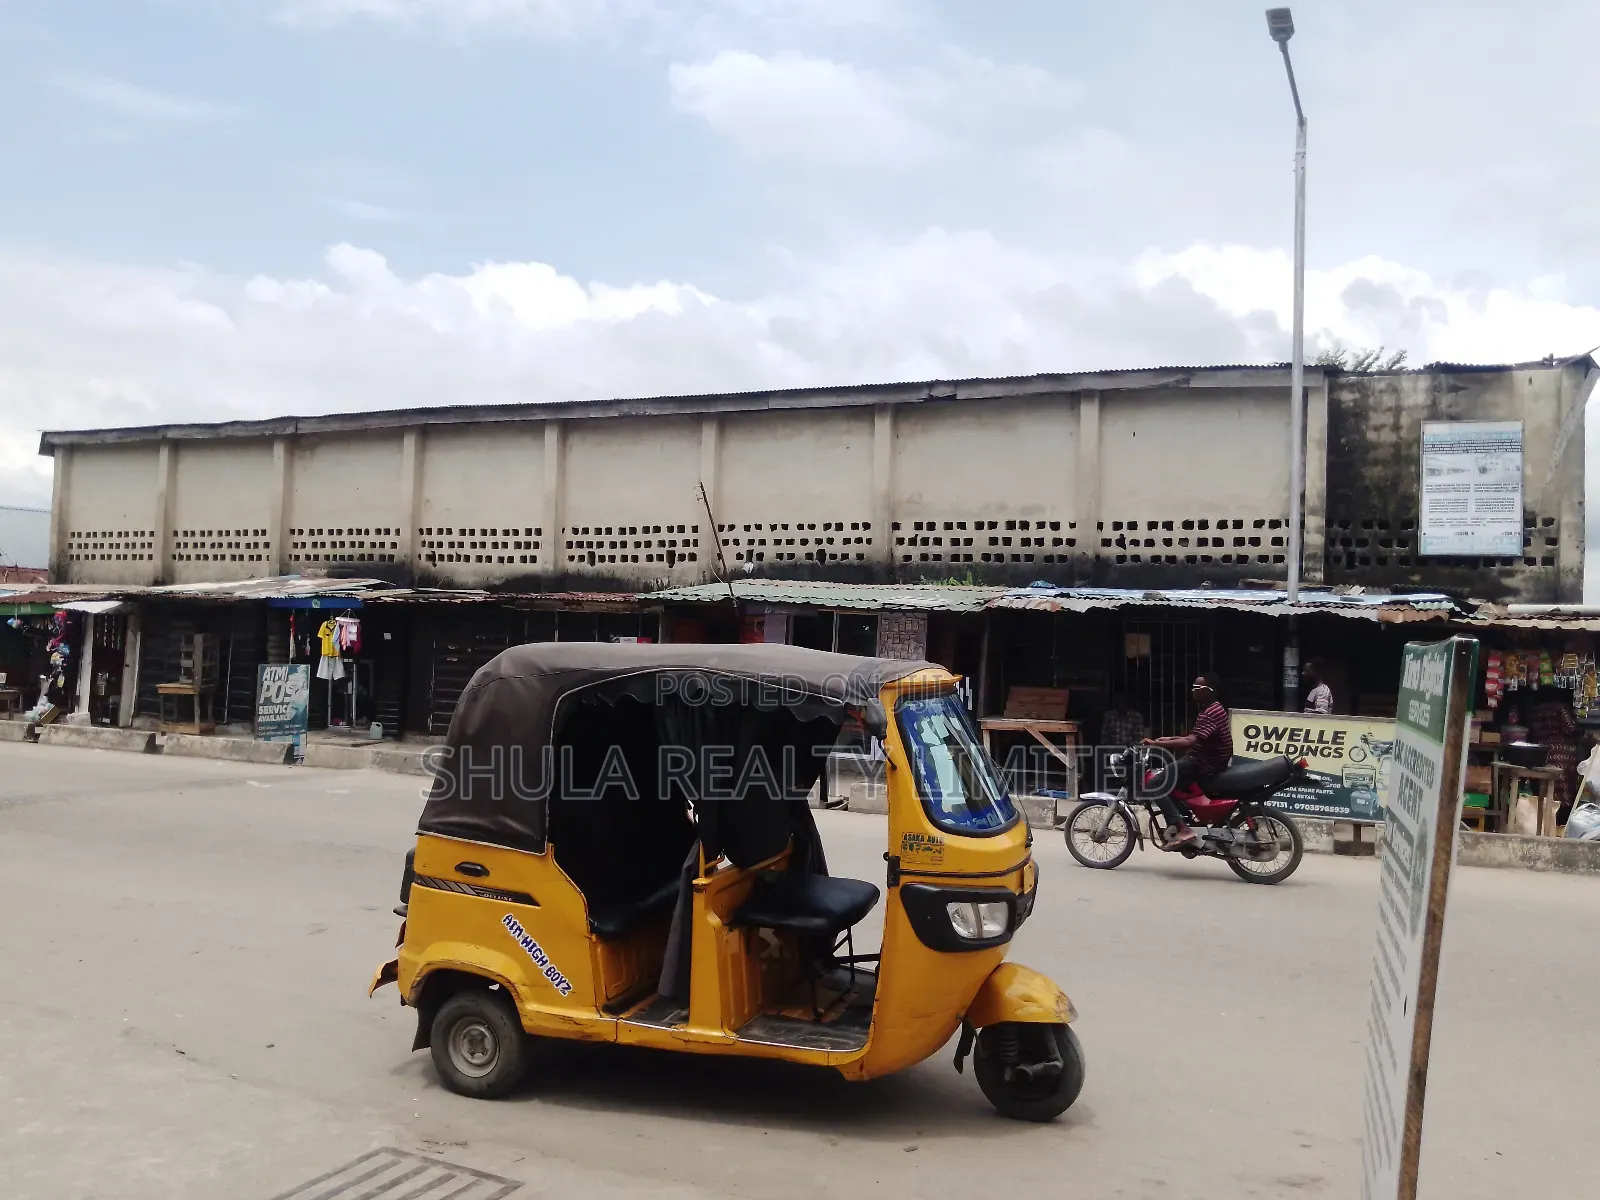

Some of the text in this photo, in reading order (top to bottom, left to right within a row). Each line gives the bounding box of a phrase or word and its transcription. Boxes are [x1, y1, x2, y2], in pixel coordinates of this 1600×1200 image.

[1243, 724, 1347, 746] OWELLE
[1245, 741, 1344, 759] HOLDINGS
[1397, 771, 1424, 825] AGENT
[903, 834, 925, 842] ASAKA
[503, 913, 572, 996] AIM HIGH BOYZ
